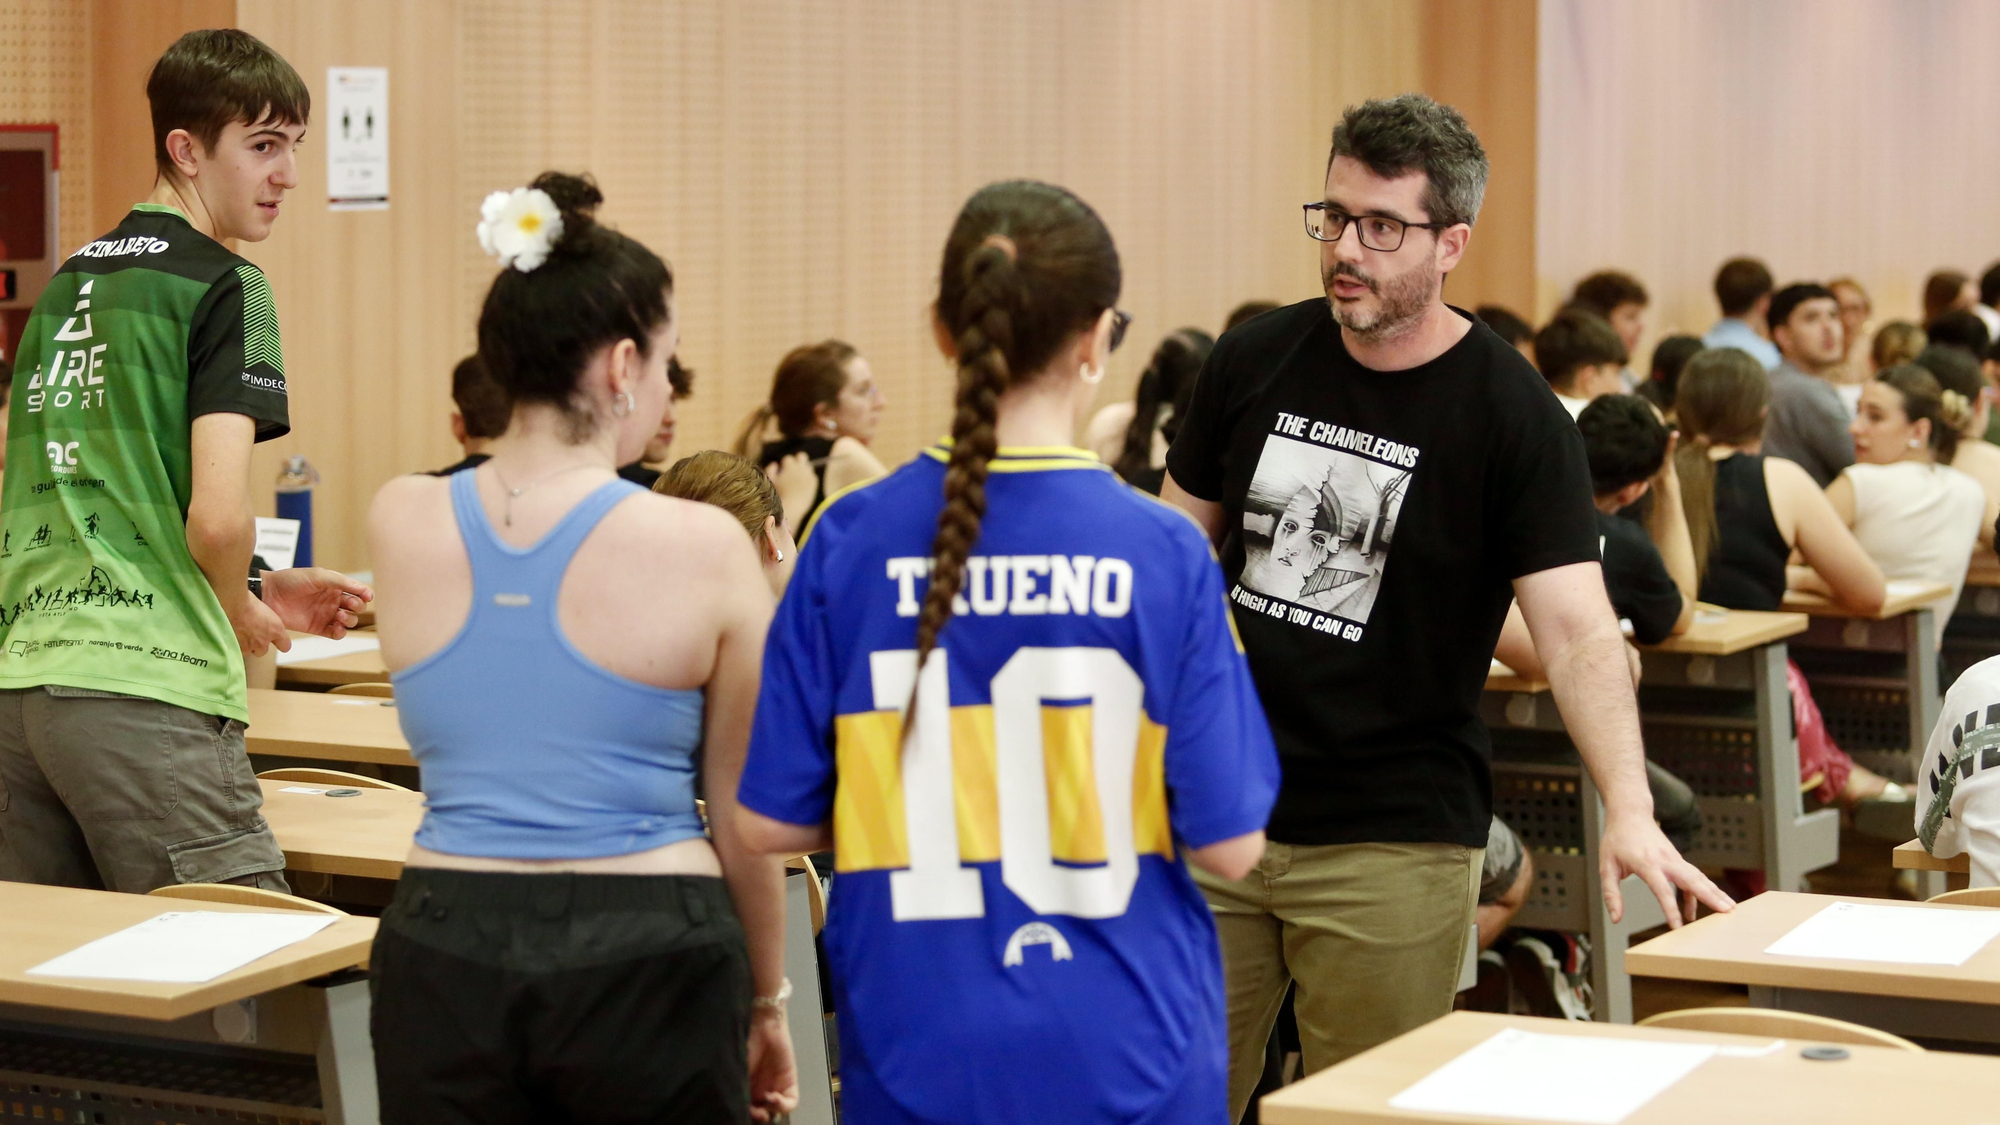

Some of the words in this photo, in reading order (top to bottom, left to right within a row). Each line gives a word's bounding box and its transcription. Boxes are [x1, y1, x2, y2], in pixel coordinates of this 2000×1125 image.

[67, 236, 169, 259] NCINAREJO
[1275, 412, 1309, 437] THE
[1309, 421, 1420, 468] CHAMELEONS
[886, 555, 1133, 618] TUENO
[1237, 591, 1267, 613] HIGH
[1267, 601, 1287, 619] AS
[1287, 607, 1312, 626] YOU
[1312, 615, 1343, 635] CAN
[1342, 625, 1363, 643] GO
[123, 644, 143, 652] verde
[180, 652, 208, 667] team
[869, 646, 1145, 922] 10
